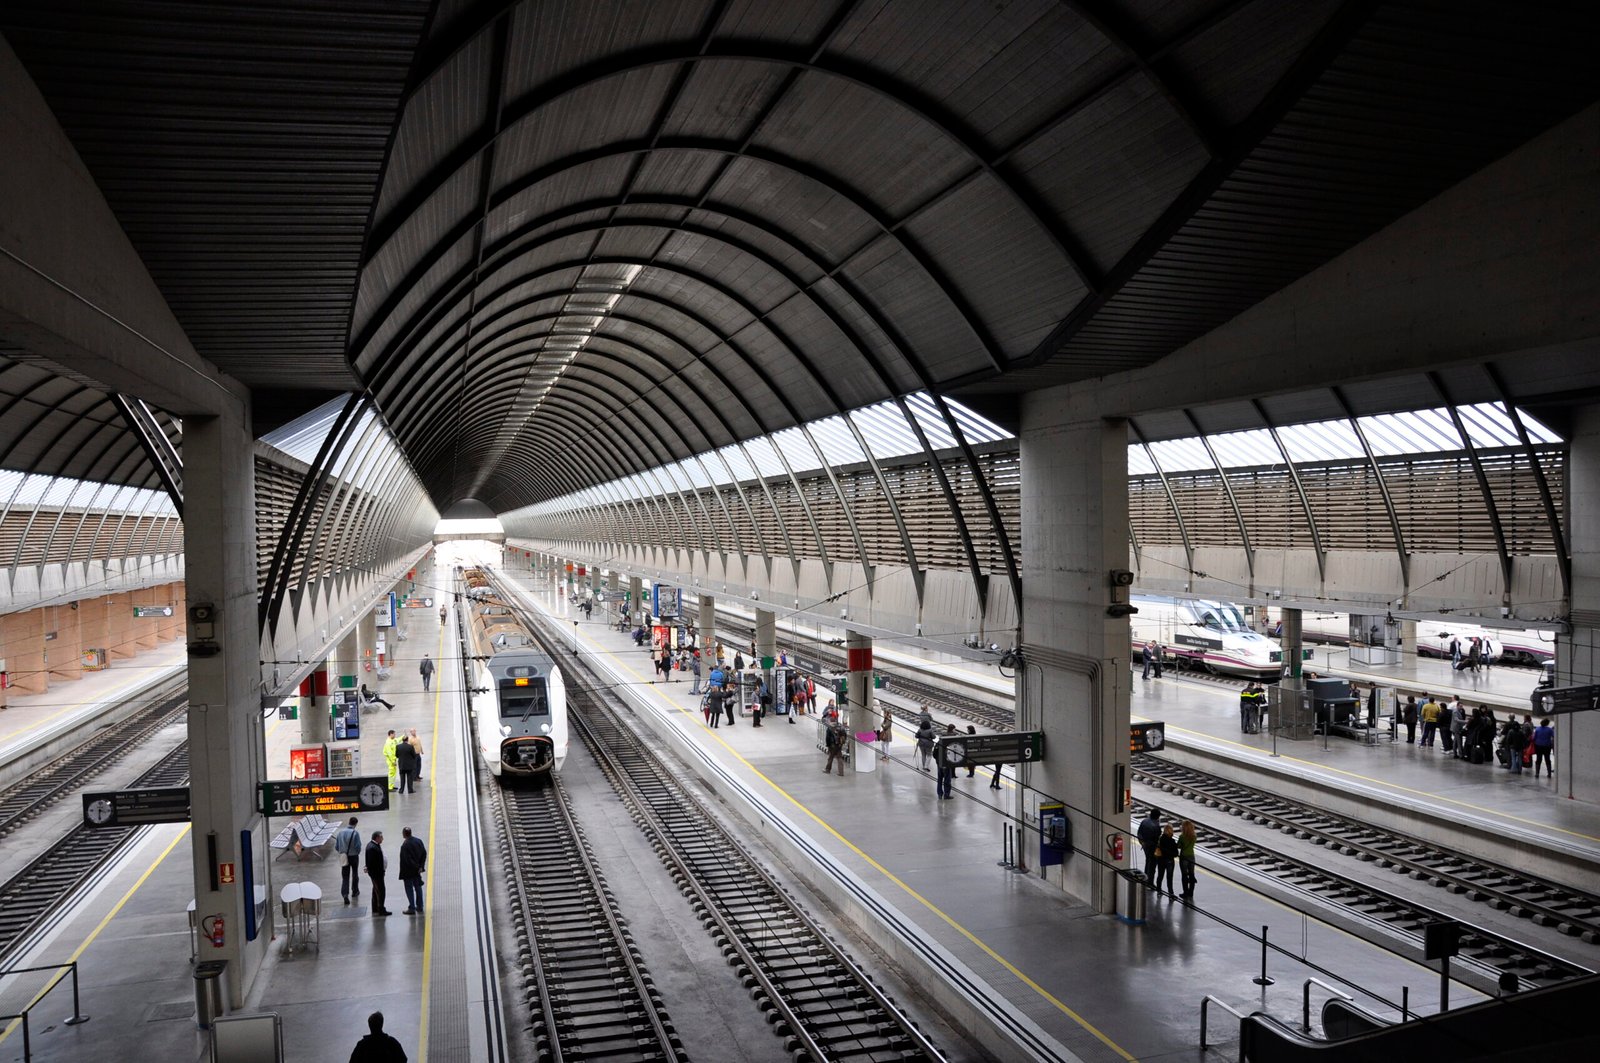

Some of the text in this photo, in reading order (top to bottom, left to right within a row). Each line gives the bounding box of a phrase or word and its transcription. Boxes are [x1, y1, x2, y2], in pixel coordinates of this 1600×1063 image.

[885, 681, 890, 689] 8
[1592, 697, 1599, 708] 7
[1024, 747, 1032, 759] 9
[273, 800, 291, 813] 10
